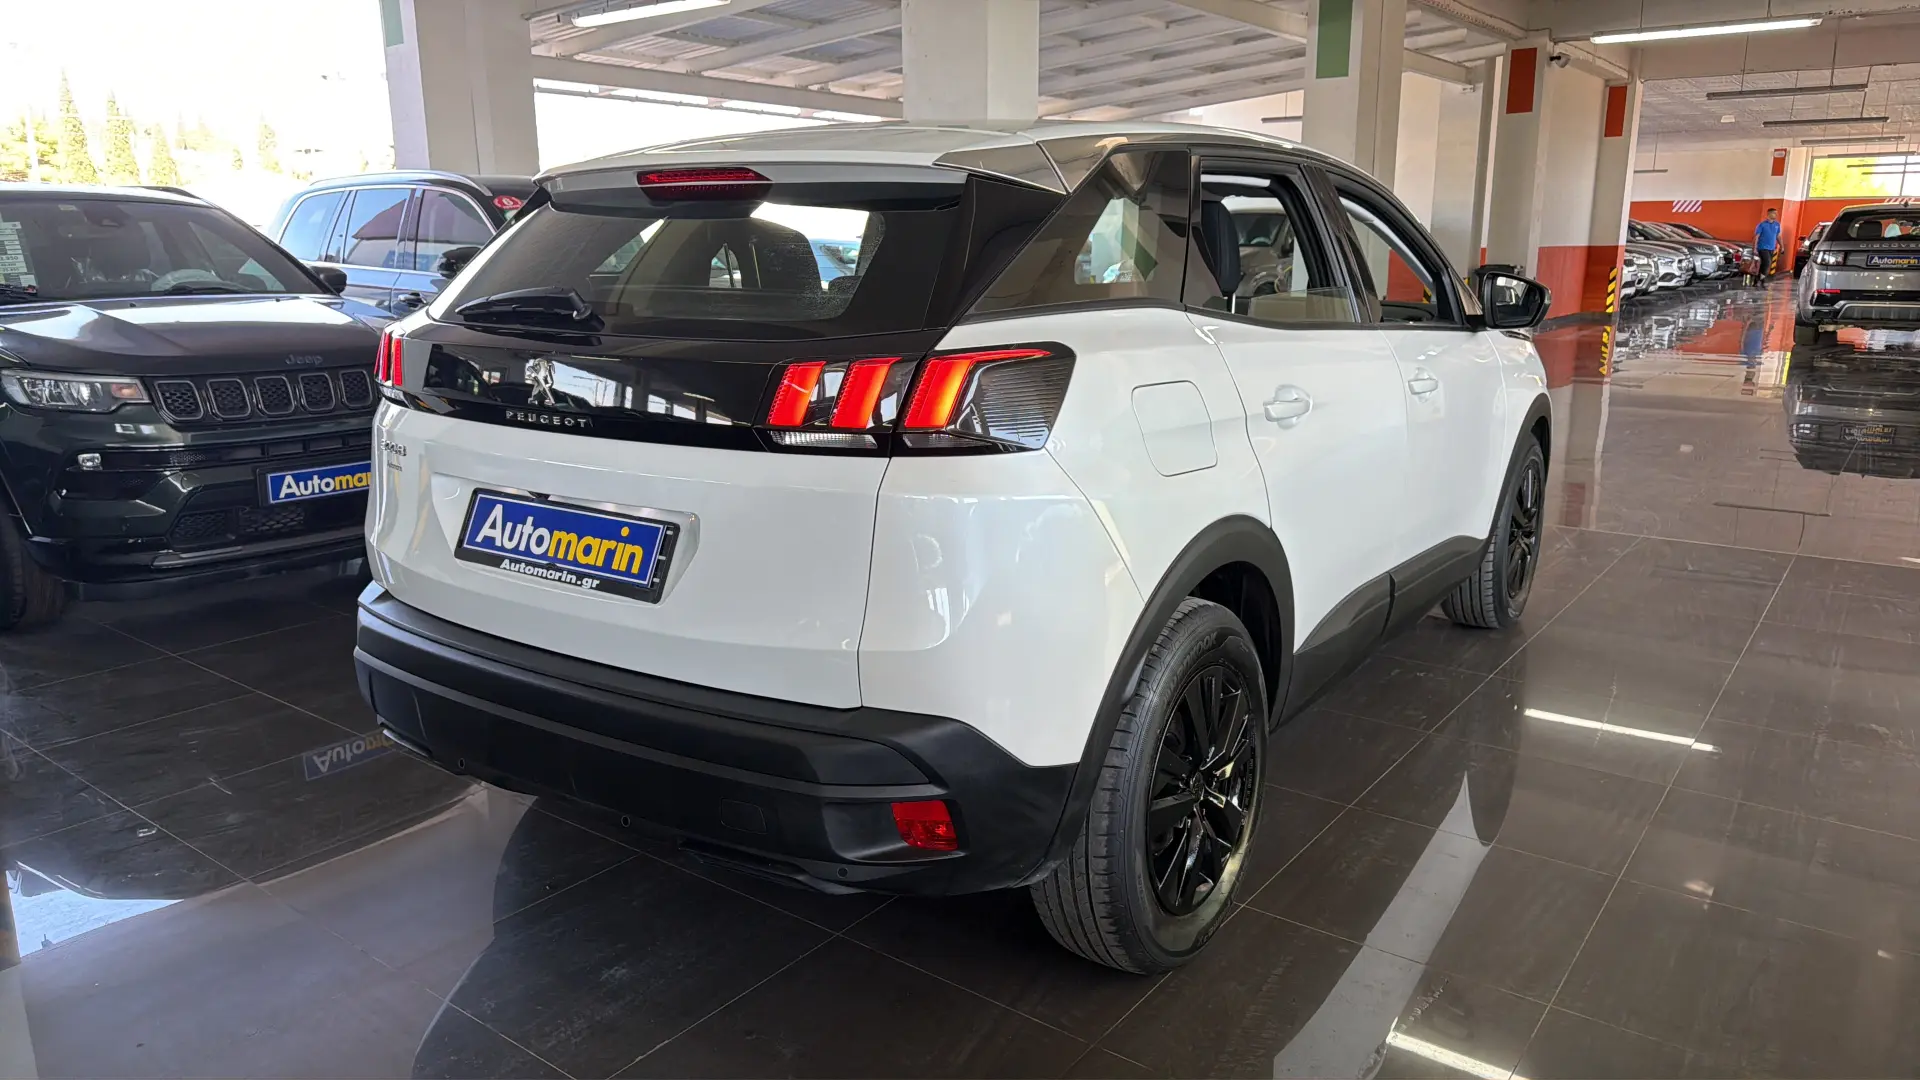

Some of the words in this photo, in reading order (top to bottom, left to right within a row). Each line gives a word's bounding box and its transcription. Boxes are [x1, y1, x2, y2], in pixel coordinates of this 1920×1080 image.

[1870, 256, 1918, 266] Automarin
[285, 354, 323, 366] Jeep
[506, 410, 587, 428] PEUGEOT
[475, 503, 643, 574] Automarin
[499, 557, 600, 589] Automarin.gr
